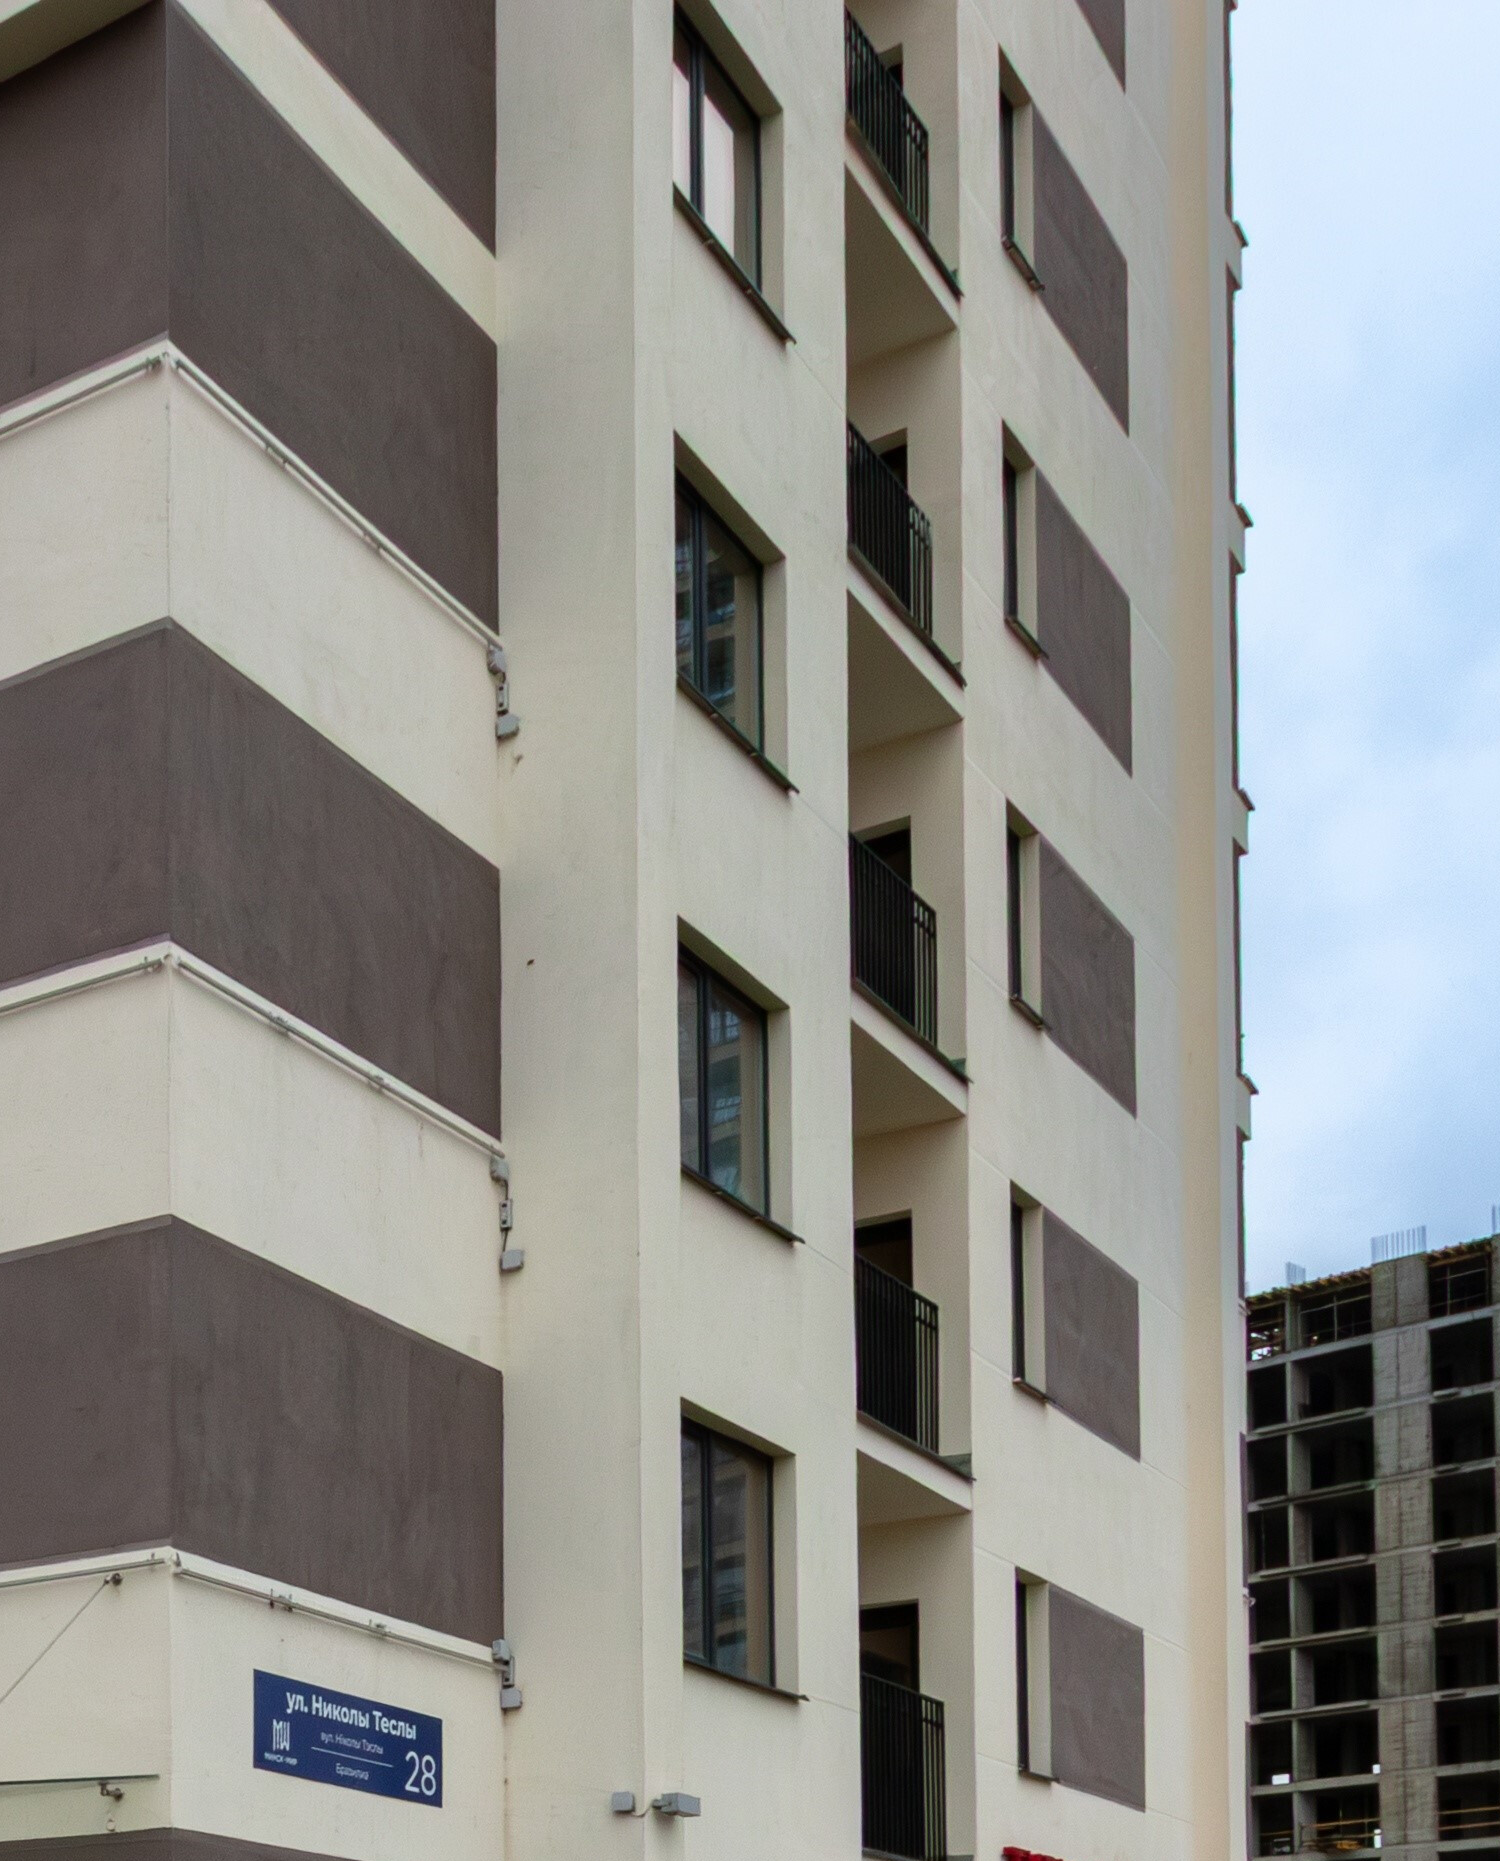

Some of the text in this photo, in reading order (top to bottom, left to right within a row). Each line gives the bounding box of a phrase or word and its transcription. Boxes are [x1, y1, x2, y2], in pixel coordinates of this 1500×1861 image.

[286, 1691, 417, 1740] ул. Николы Теслы
[405, 1750, 437, 1796] 28
